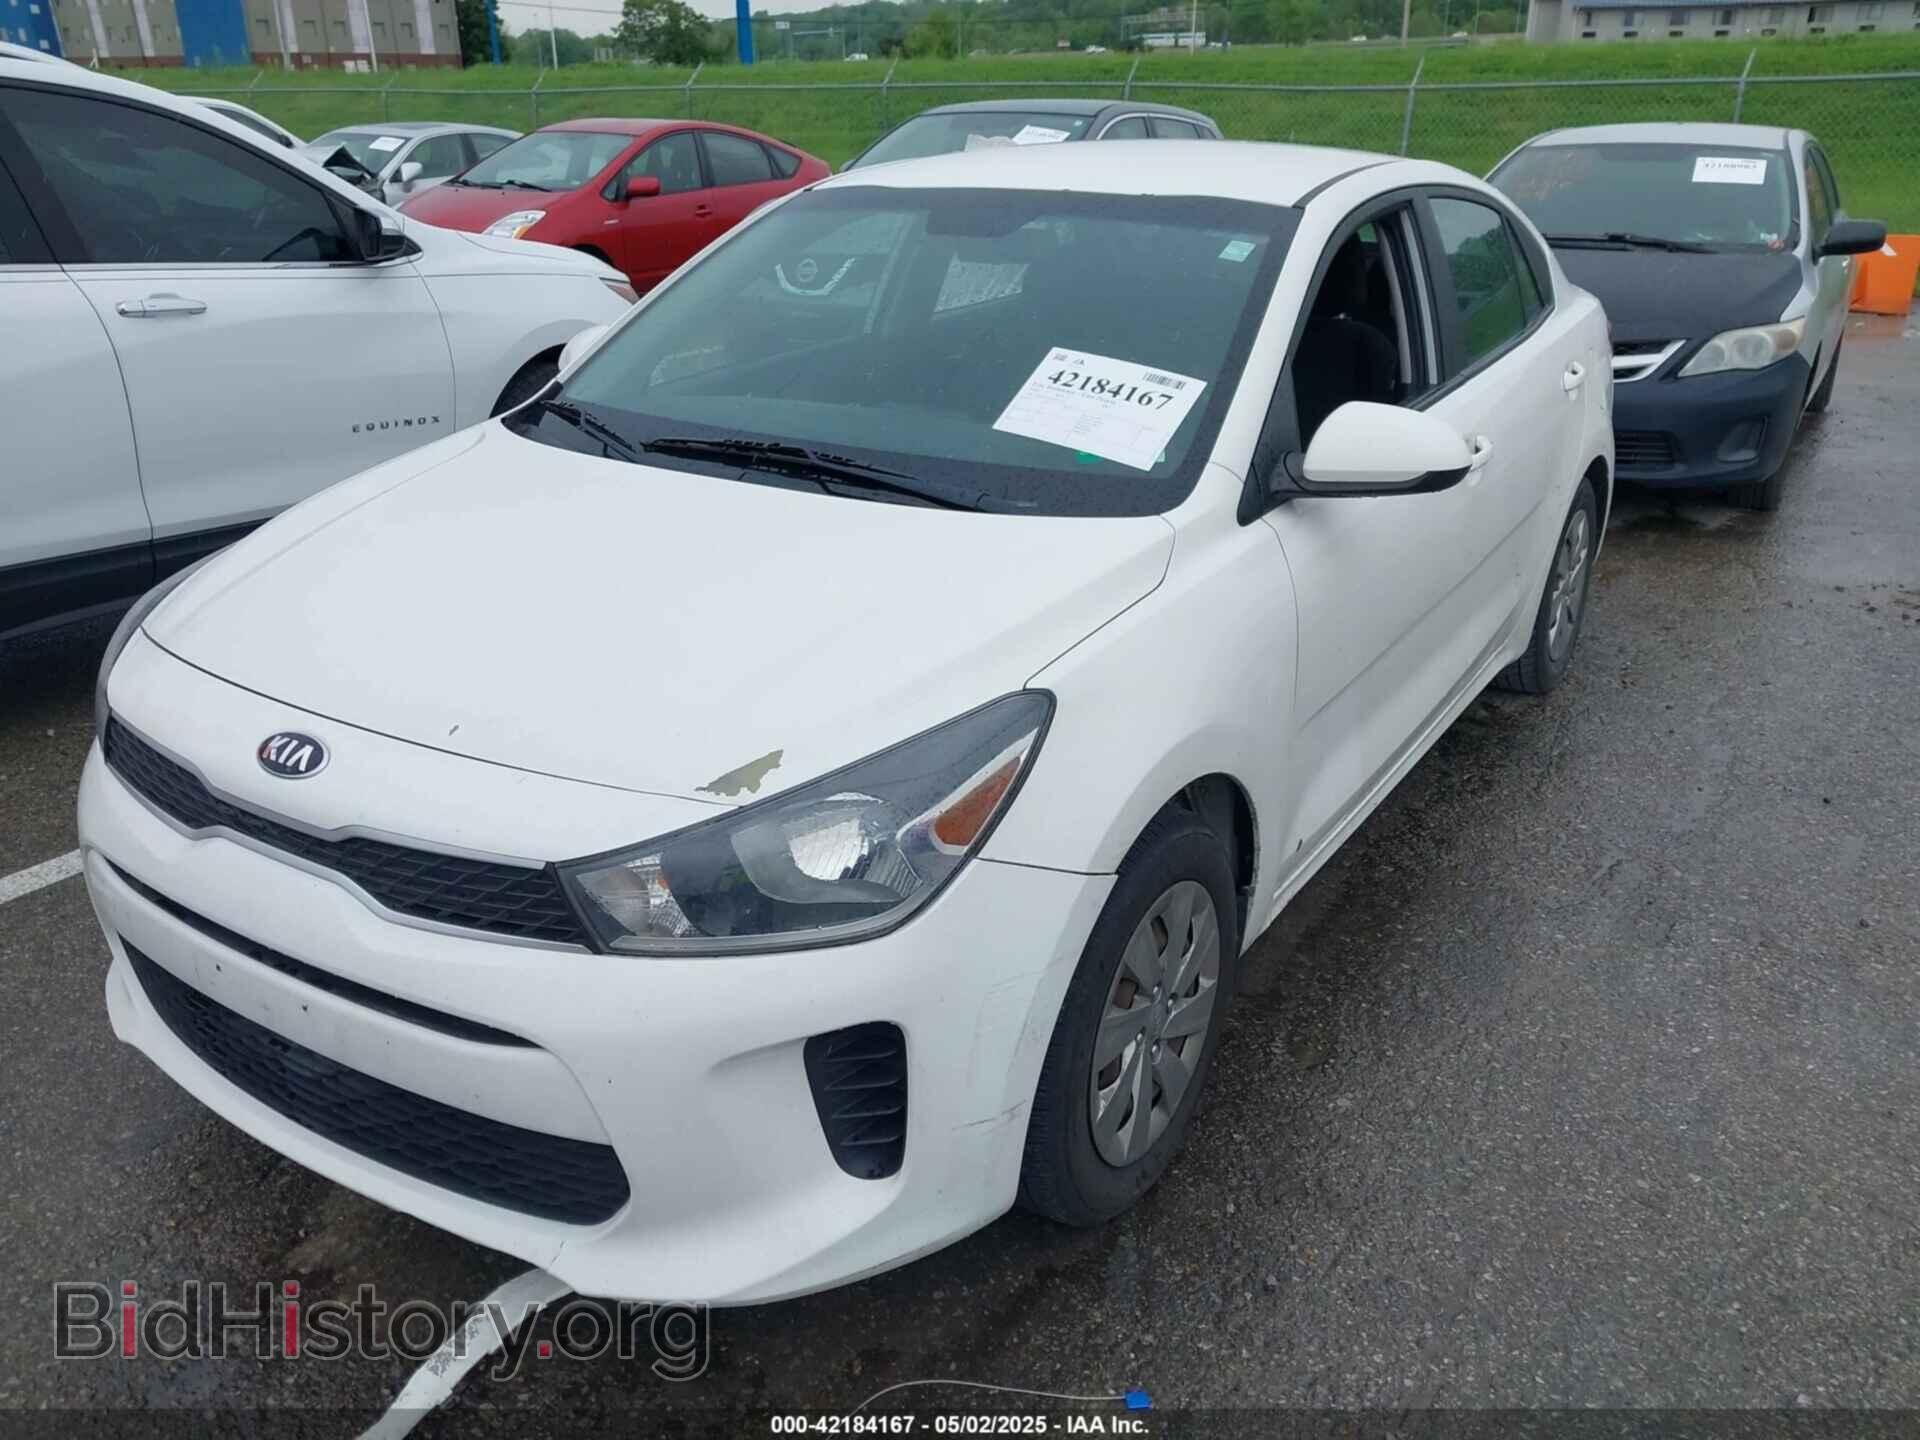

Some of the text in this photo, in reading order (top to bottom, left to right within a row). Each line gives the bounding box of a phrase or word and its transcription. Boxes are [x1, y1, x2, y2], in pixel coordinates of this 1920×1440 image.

[1048, 369, 1175, 411] 42184167
[352, 415, 440, 433] EQUINOX
[261, 735, 314, 772] KIA
